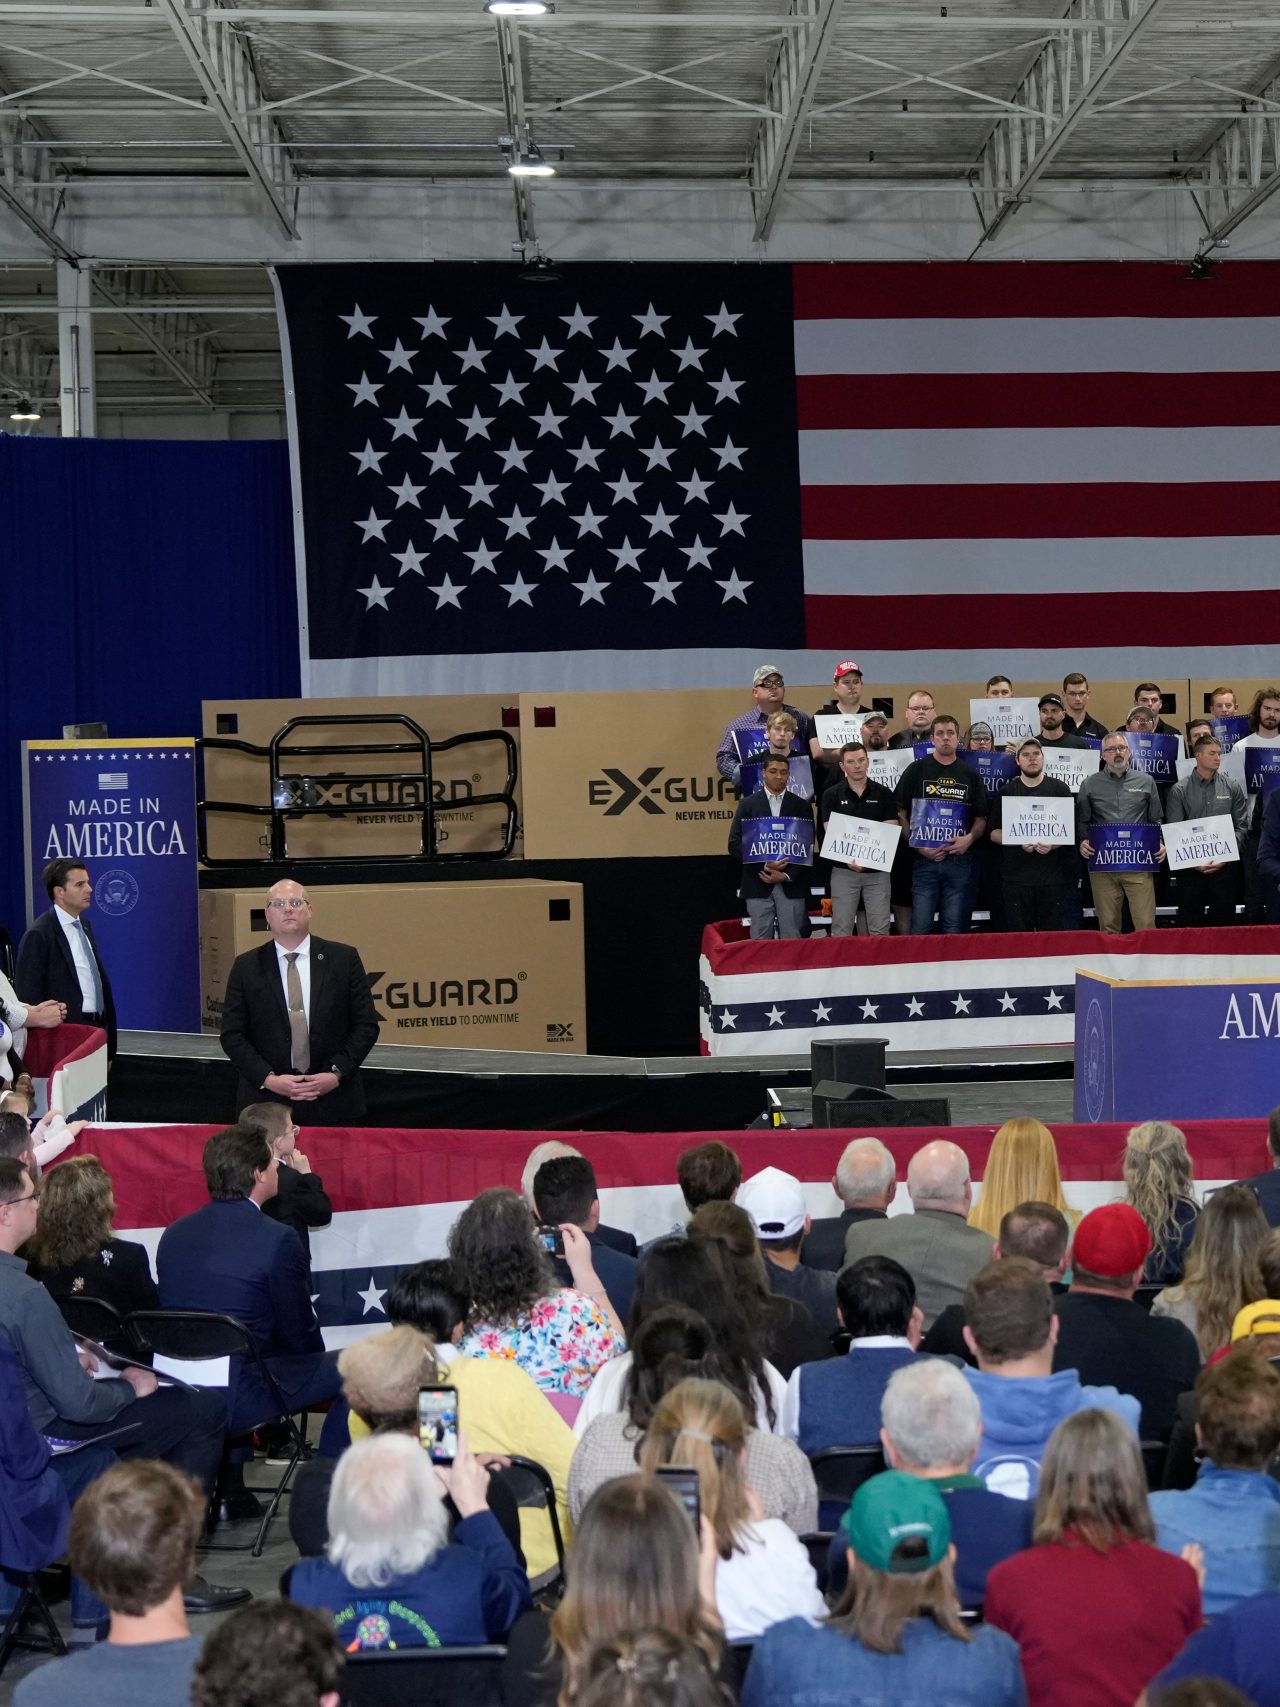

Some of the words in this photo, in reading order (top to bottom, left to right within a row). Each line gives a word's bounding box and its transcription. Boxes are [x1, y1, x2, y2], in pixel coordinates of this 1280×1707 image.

[993, 724, 1034, 738] ERICA
[825, 734, 860, 744] AMER
[69, 798, 131, 816] MADE
[140, 798, 160, 814] IN
[357, 814, 386, 824] NEVER
[388, 814, 414, 823] YIELD
[675, 811, 706, 821] NEVER
[707, 810, 734, 820] YIELD
[927, 817, 953, 825] MADE
[759, 832, 786, 840] MADE
[789, 833, 798, 841] IN
[915, 826, 966, 841] AMERIC
[1009, 823, 1068, 837] AMERICA
[43, 820, 187, 859] AMERICA
[843, 833, 868, 844] MADE
[1181, 834, 1207, 845] MADE
[749, 841, 808, 858] AMERICA
[828, 840, 887, 863] AMERICA
[1175, 841, 1232, 862] AMERICA
[1095, 850, 1154, 864] AMERICA
[397, 1017, 428, 1028] NEVER
[430, 1015, 457, 1026] YIELD
[459, 1015, 471, 1025] TO
[472, 1013, 519, 1025] DOWNTIME
